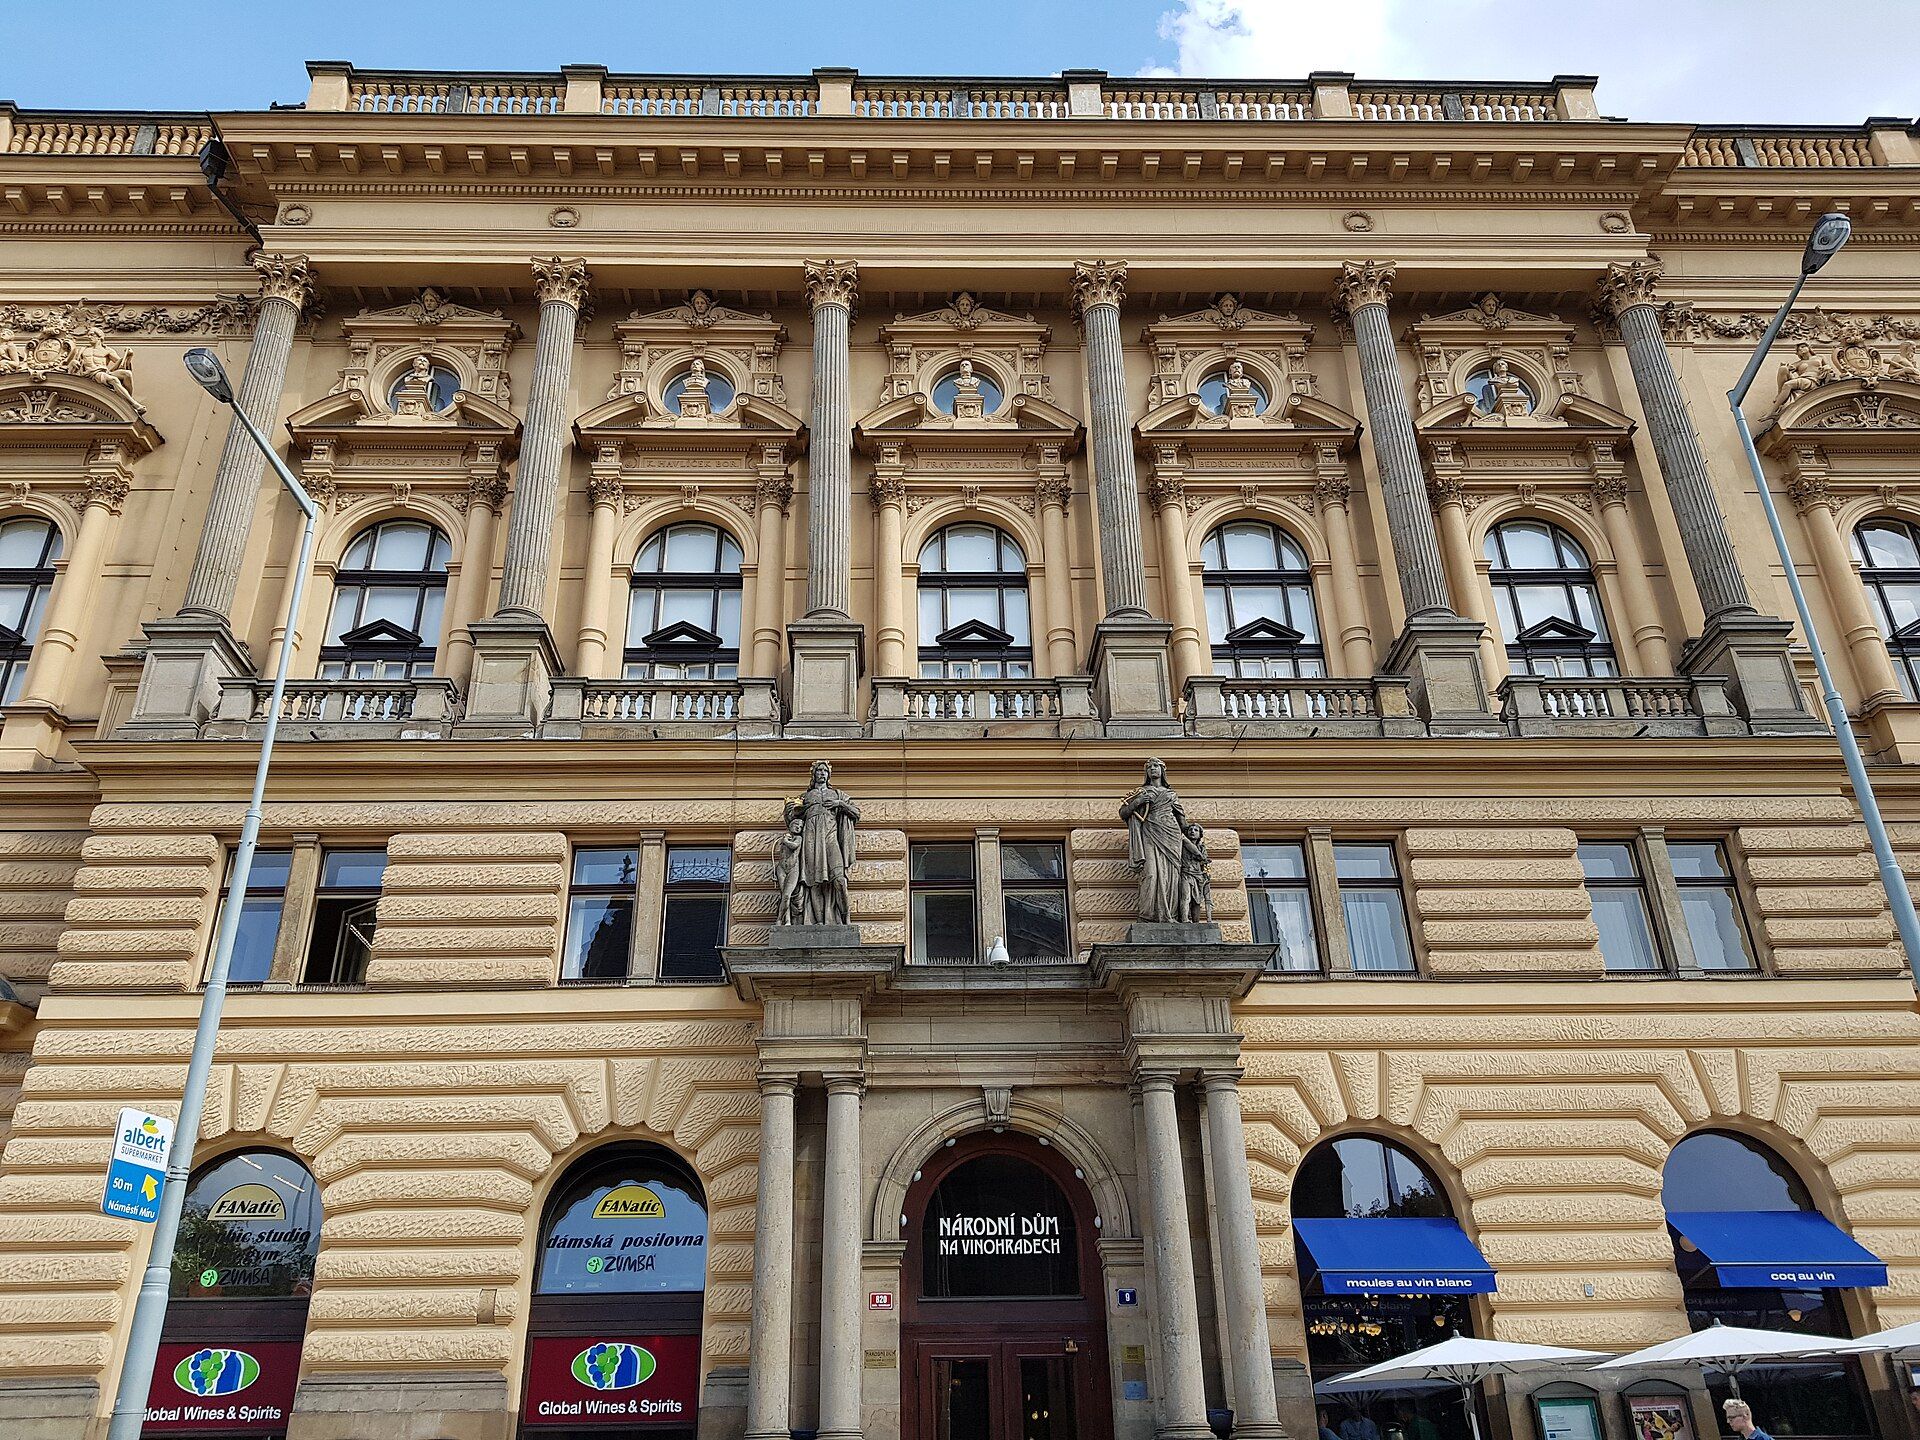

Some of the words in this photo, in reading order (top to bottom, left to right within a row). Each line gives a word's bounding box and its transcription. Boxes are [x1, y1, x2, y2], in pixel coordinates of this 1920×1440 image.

[123, 1127, 166, 1152] albert
[120, 1145, 163, 1164] SUPERMARKET
[112, 1177, 124, 1190] 50
[123, 1182, 133, 1192] m
[107, 1199, 140, 1215] Náměstí
[138, 1206, 156, 1219] Míru
[215, 1199, 282, 1214] FANatic
[599, 1199, 661, 1213] FANatic
[939, 1212, 1016, 1236] NÁRODNÍ
[1021, 1212, 1060, 1236] DŮM
[547, 1233, 615, 1249] dámská
[620, 1232, 704, 1251] posilovna
[939, 1239, 958, 1255] NA
[961, 1238, 1061, 1255] VINOHRADECH
[604, 1254, 655, 1273] ZUMBA
[219, 1268, 270, 1286] ZUMBA
[1346, 1278, 1394, 1287] moules
[1414, 1278, 1434, 1287] vin
[1435, 1278, 1473, 1287] blanc
[1770, 1271, 1797, 1281] coq
[1798, 1272, 1813, 1280] au
[1815, 1271, 1835, 1280] vin
[143, 1406, 181, 1421] lobal
[184, 1406, 225, 1420] Wines
[226, 1405, 237, 1420] &
[238, 1405, 282, 1422] Spirits
[539, 1400, 582, 1415] Global
[585, 1400, 626, 1414] Wines
[627, 1399, 638, 1413] &
[640, 1399, 682, 1416] Spirits
